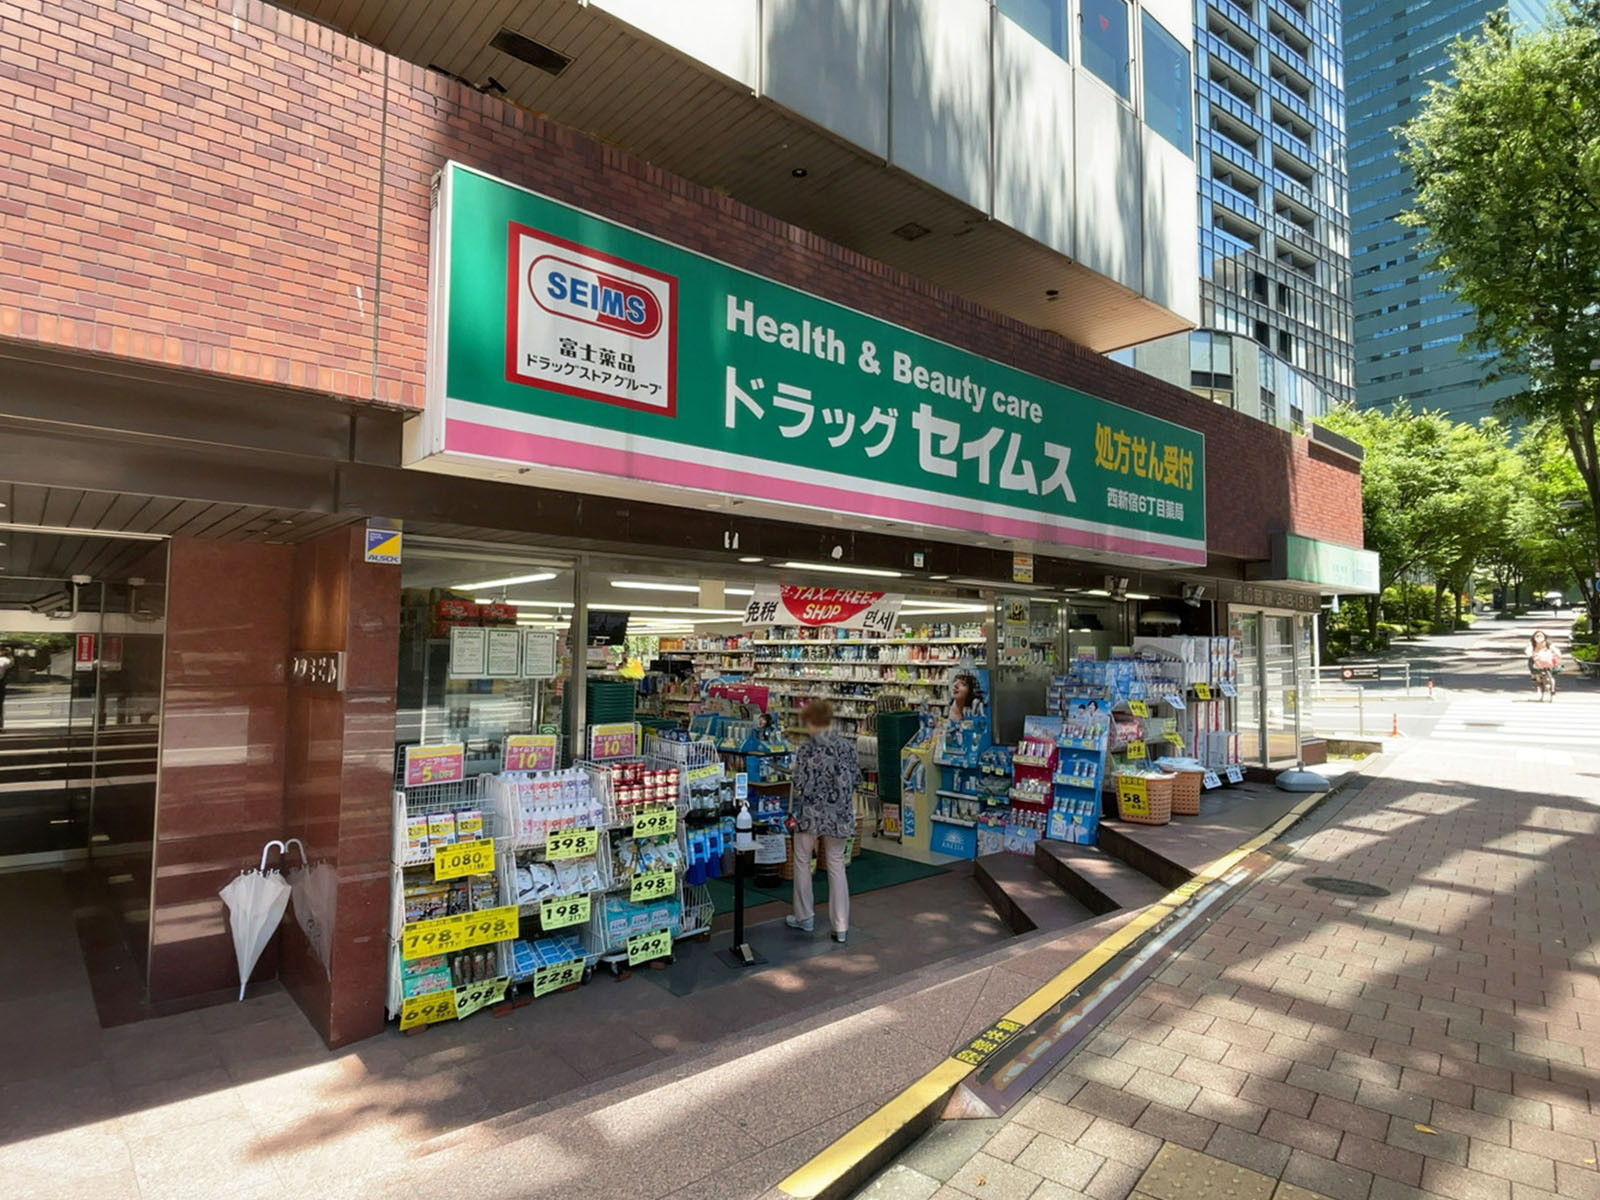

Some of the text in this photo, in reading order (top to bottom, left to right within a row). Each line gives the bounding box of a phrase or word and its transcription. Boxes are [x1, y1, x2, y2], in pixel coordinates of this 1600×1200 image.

[547, 271, 646, 324] SEIMS
[558, 337, 636, 373] 富士薬品
[726, 295, 1043, 424] Health & Beauty care
[725, 366, 1076, 502] ドラッグ セイムス
[1095, 422, 1193, 491] 処方せん受付
[1107, 487, 1184, 522] 西新宿6丁目薬局
[368, 554, 399, 563] ALSOK
[746, 601, 778, 622] 免税
[803, 603, 841, 620] SHOP
[863, 610, 895, 631] 면세
[604, 740, 620, 756] 10
[519, 752, 537, 768] 10
[1123, 793, 1141, 804] 58
[636, 816, 667, 829] 698
[550, 837, 586, 851] 398
[634, 878, 665, 892] 498
[546, 904, 579, 920] 198
[465, 919, 506, 937] 798
[407, 929, 452, 949] 798
[630, 939, 661, 956] 649
[537, 968, 573, 986] 228
[457, 987, 494, 1008] 698
[405, 1001, 449, 1020] 698
